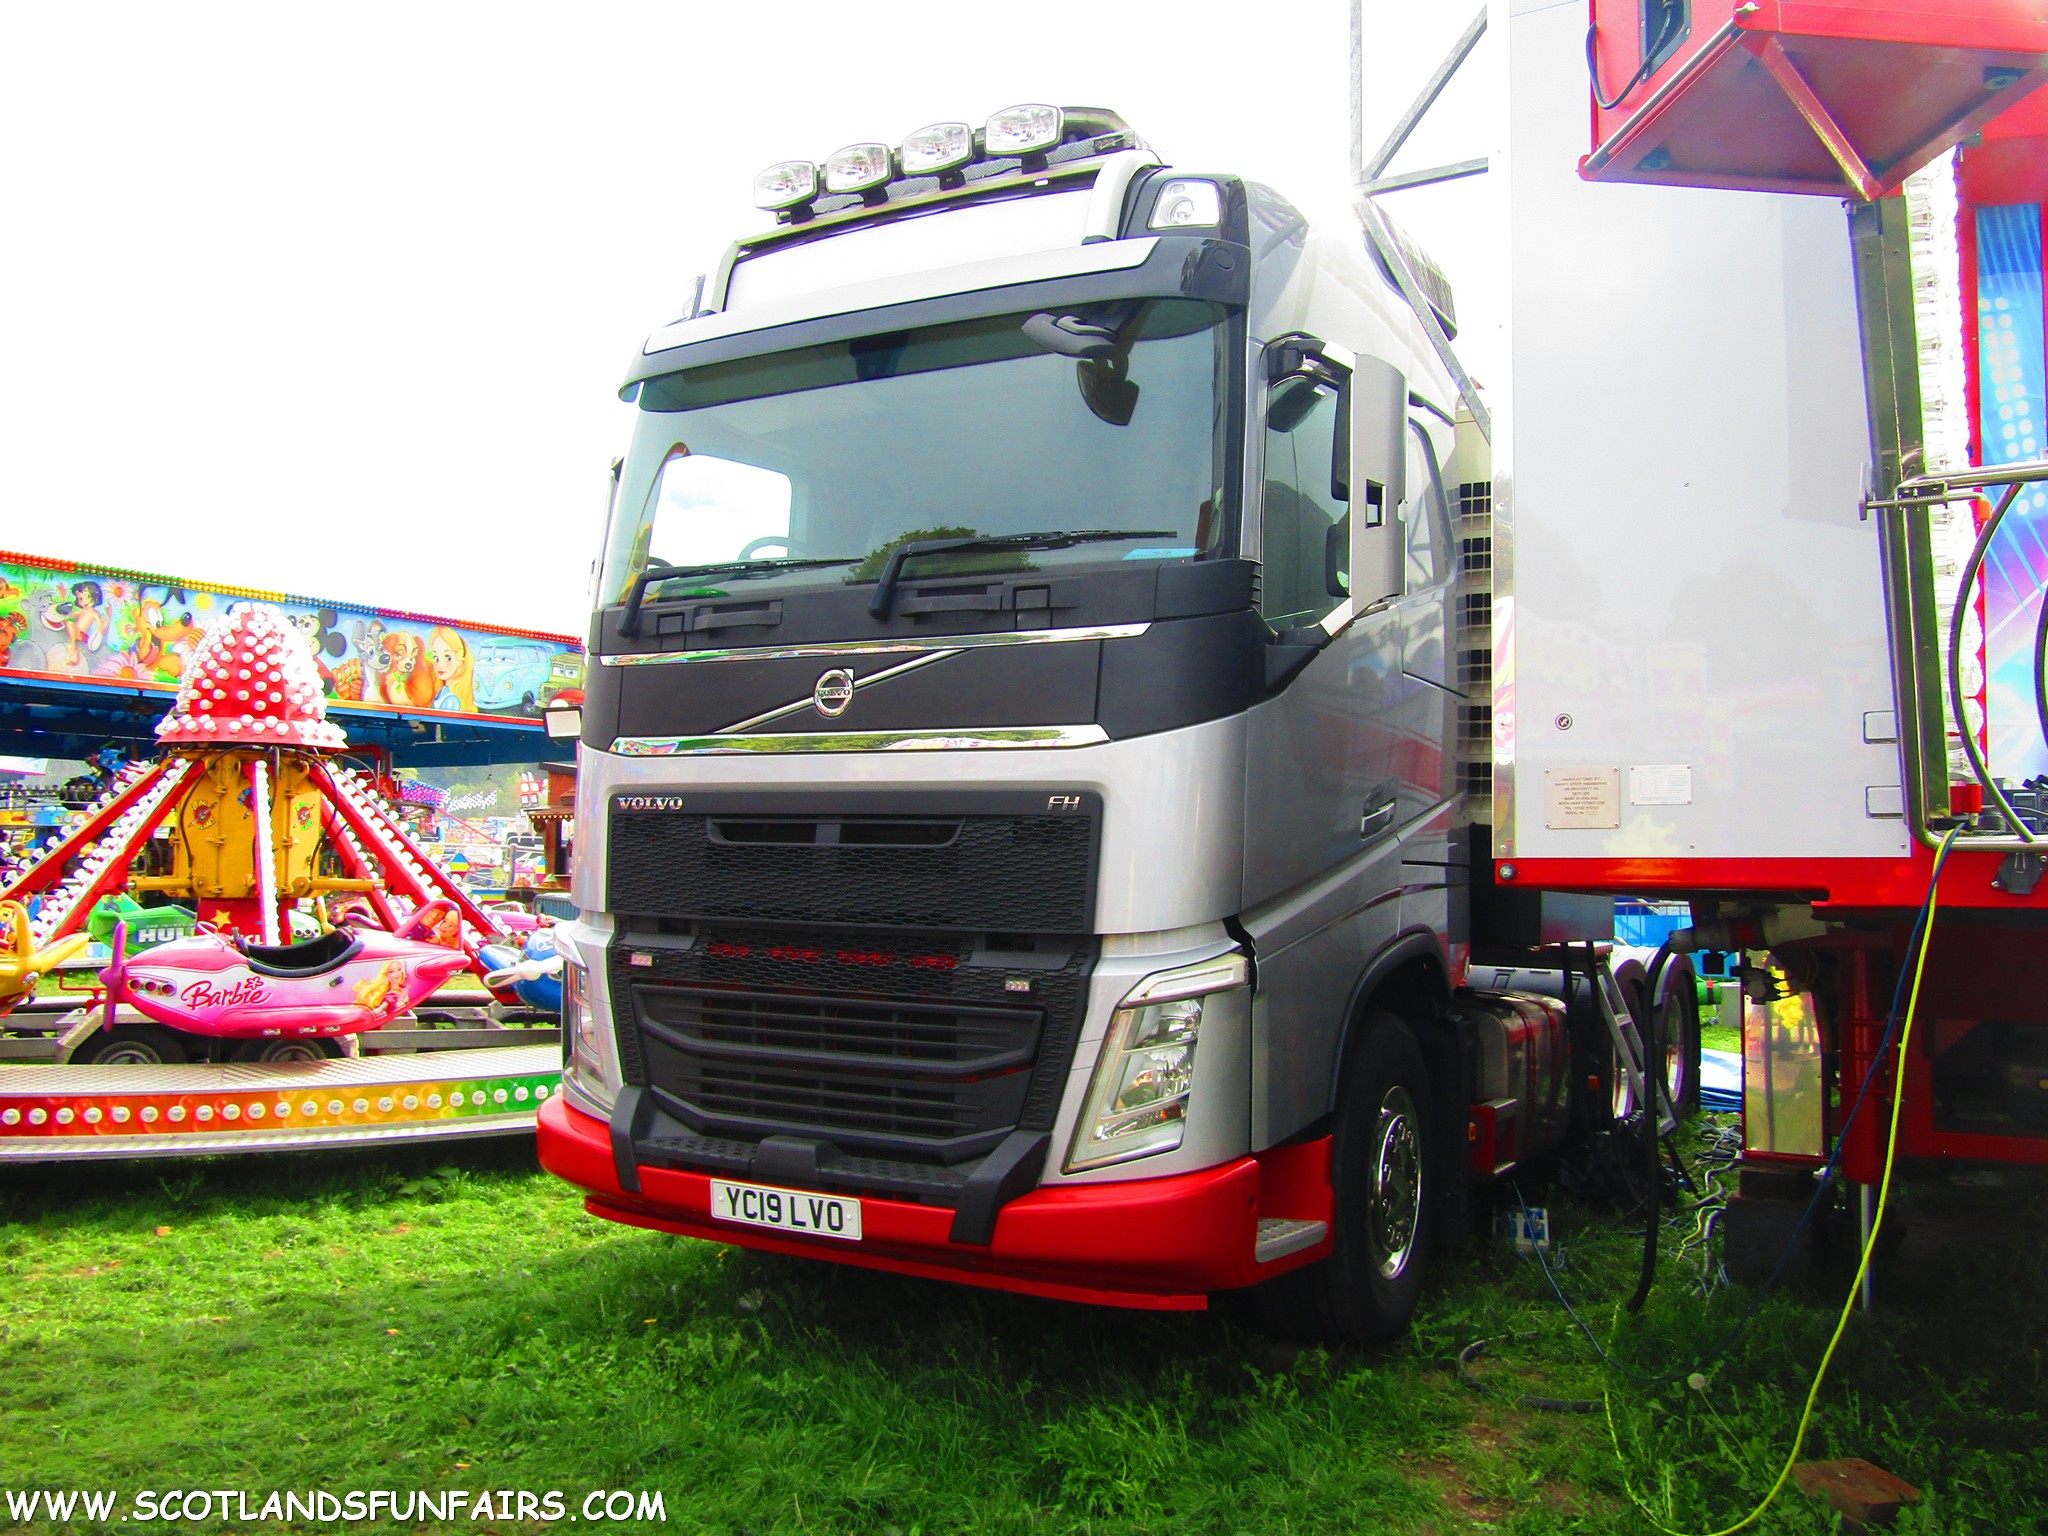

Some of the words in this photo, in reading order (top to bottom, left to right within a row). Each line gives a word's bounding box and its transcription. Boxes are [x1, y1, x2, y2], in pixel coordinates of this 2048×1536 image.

[617, 796, 683, 811] VOLVO
[1047, 796, 1080, 811] FH
[181, 977, 271, 1011] Barbie
[726, 1187, 782, 1223] YC19
[790, 1196, 844, 1232] LVO
